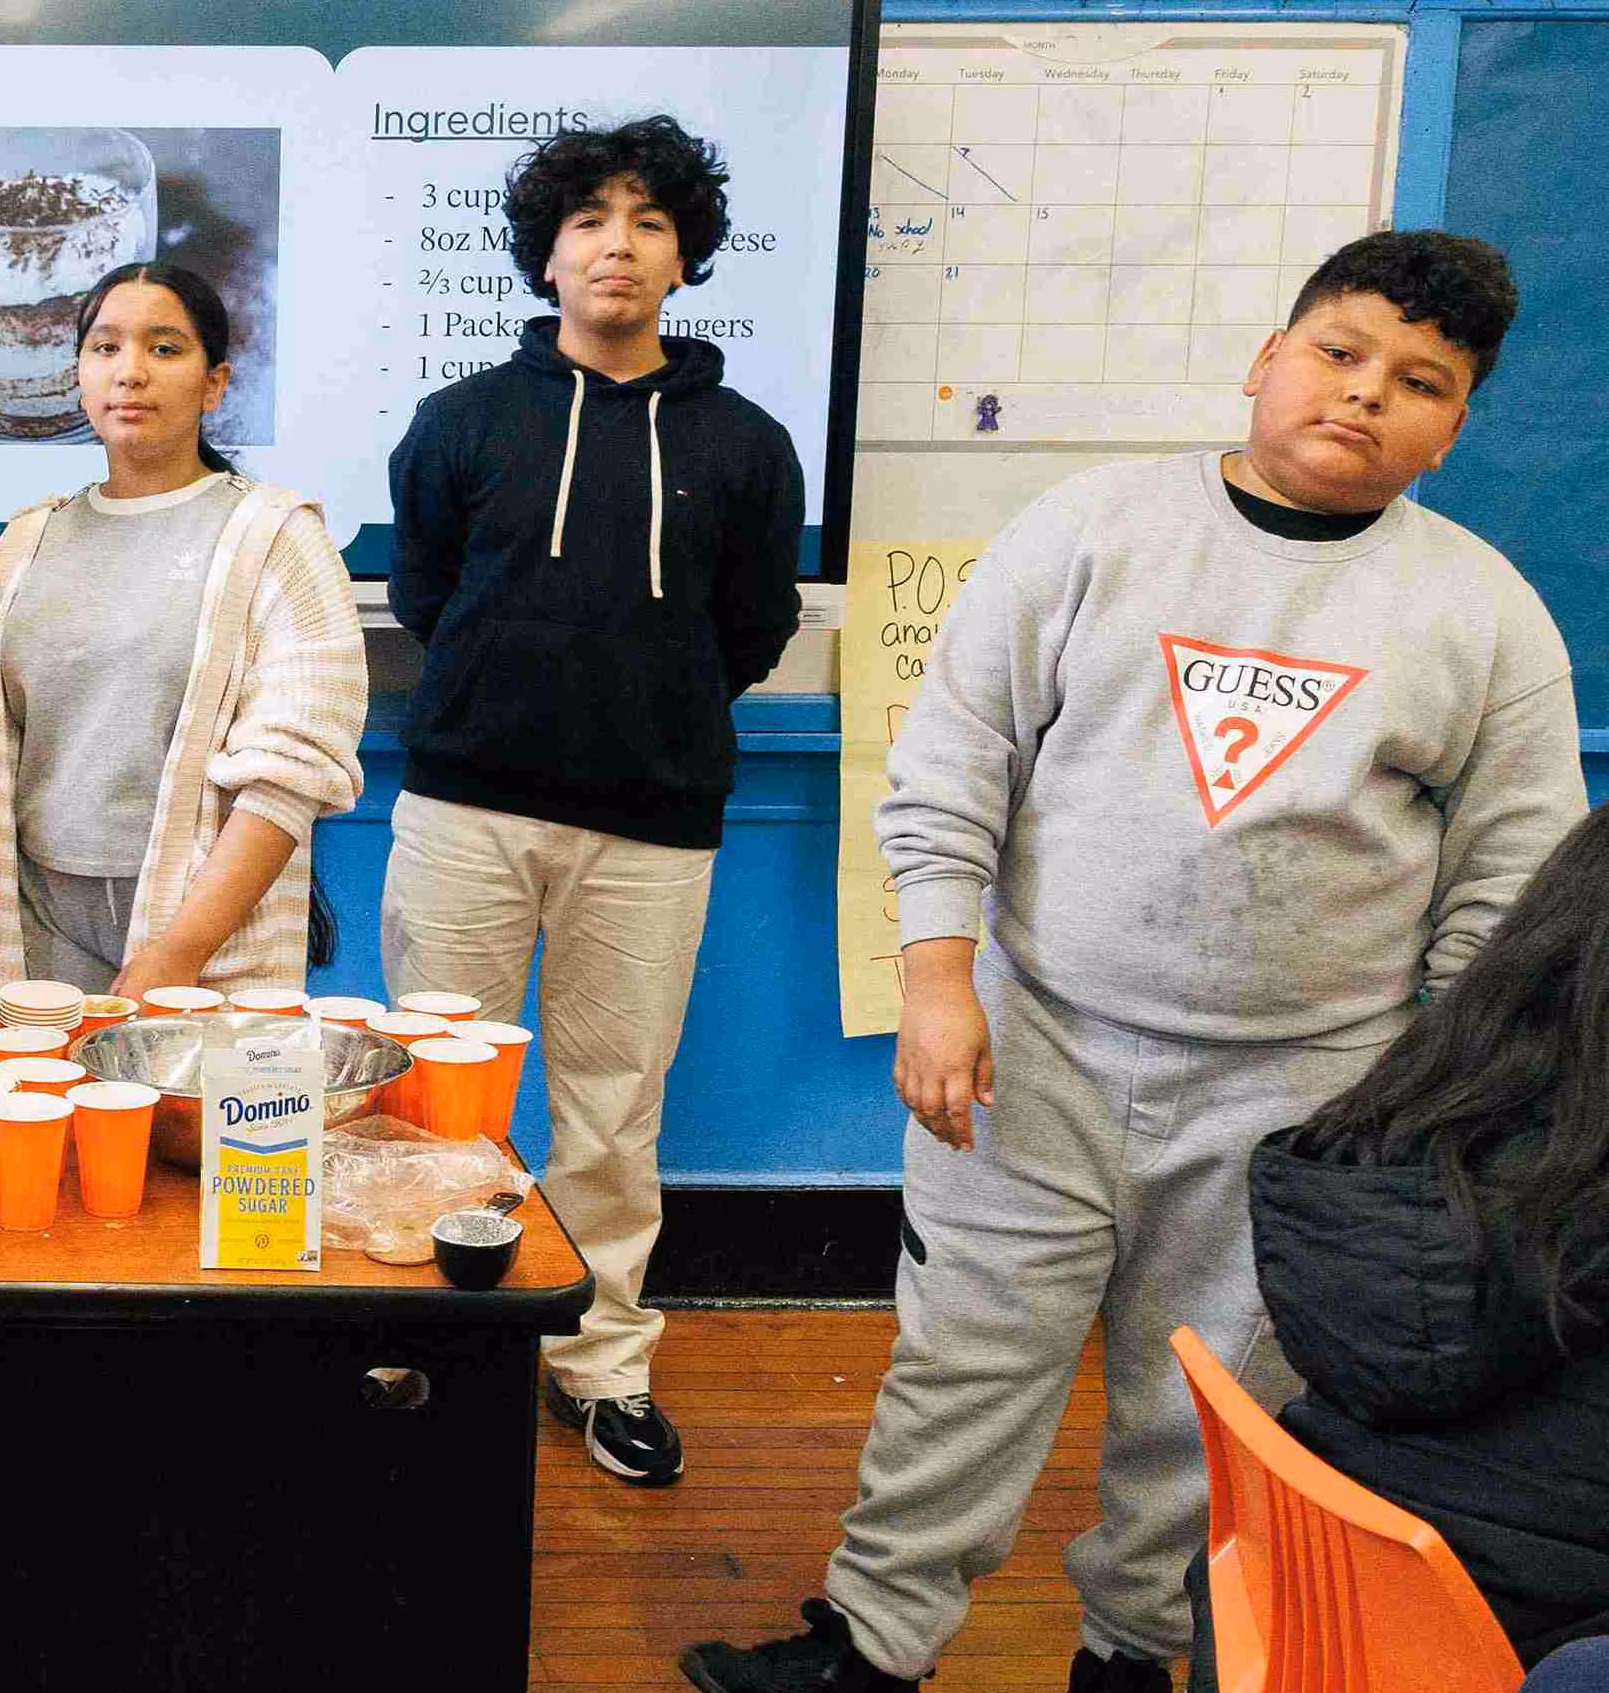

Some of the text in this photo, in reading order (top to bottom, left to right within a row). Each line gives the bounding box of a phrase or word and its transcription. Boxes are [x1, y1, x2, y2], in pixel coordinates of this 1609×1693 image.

[876, 68, 1350, 81] Monday Tuesday Wednesday Thursday Friday Saturday
[374, 103, 589, 142] Ingredients
[422, 183, 436, 208] 3
[951, 207, 965, 218] 14
[1037, 208, 1049, 219] 15
[420, 227, 471, 251] 8oz
[716, 231, 777, 251] eese
[460, 275, 513, 301] cup
[419, 313, 431, 337] 1
[445, 313, 525, 337] Packa
[417, 356, 428, 379] 1
[1184, 660, 1321, 711] GUESS
[246, 1049, 281, 1062] Domino
[219, 1091, 311, 1126] Domino
[213, 1176, 316, 1196] POWDERED
[238, 1198, 288, 1213] SUGAR
